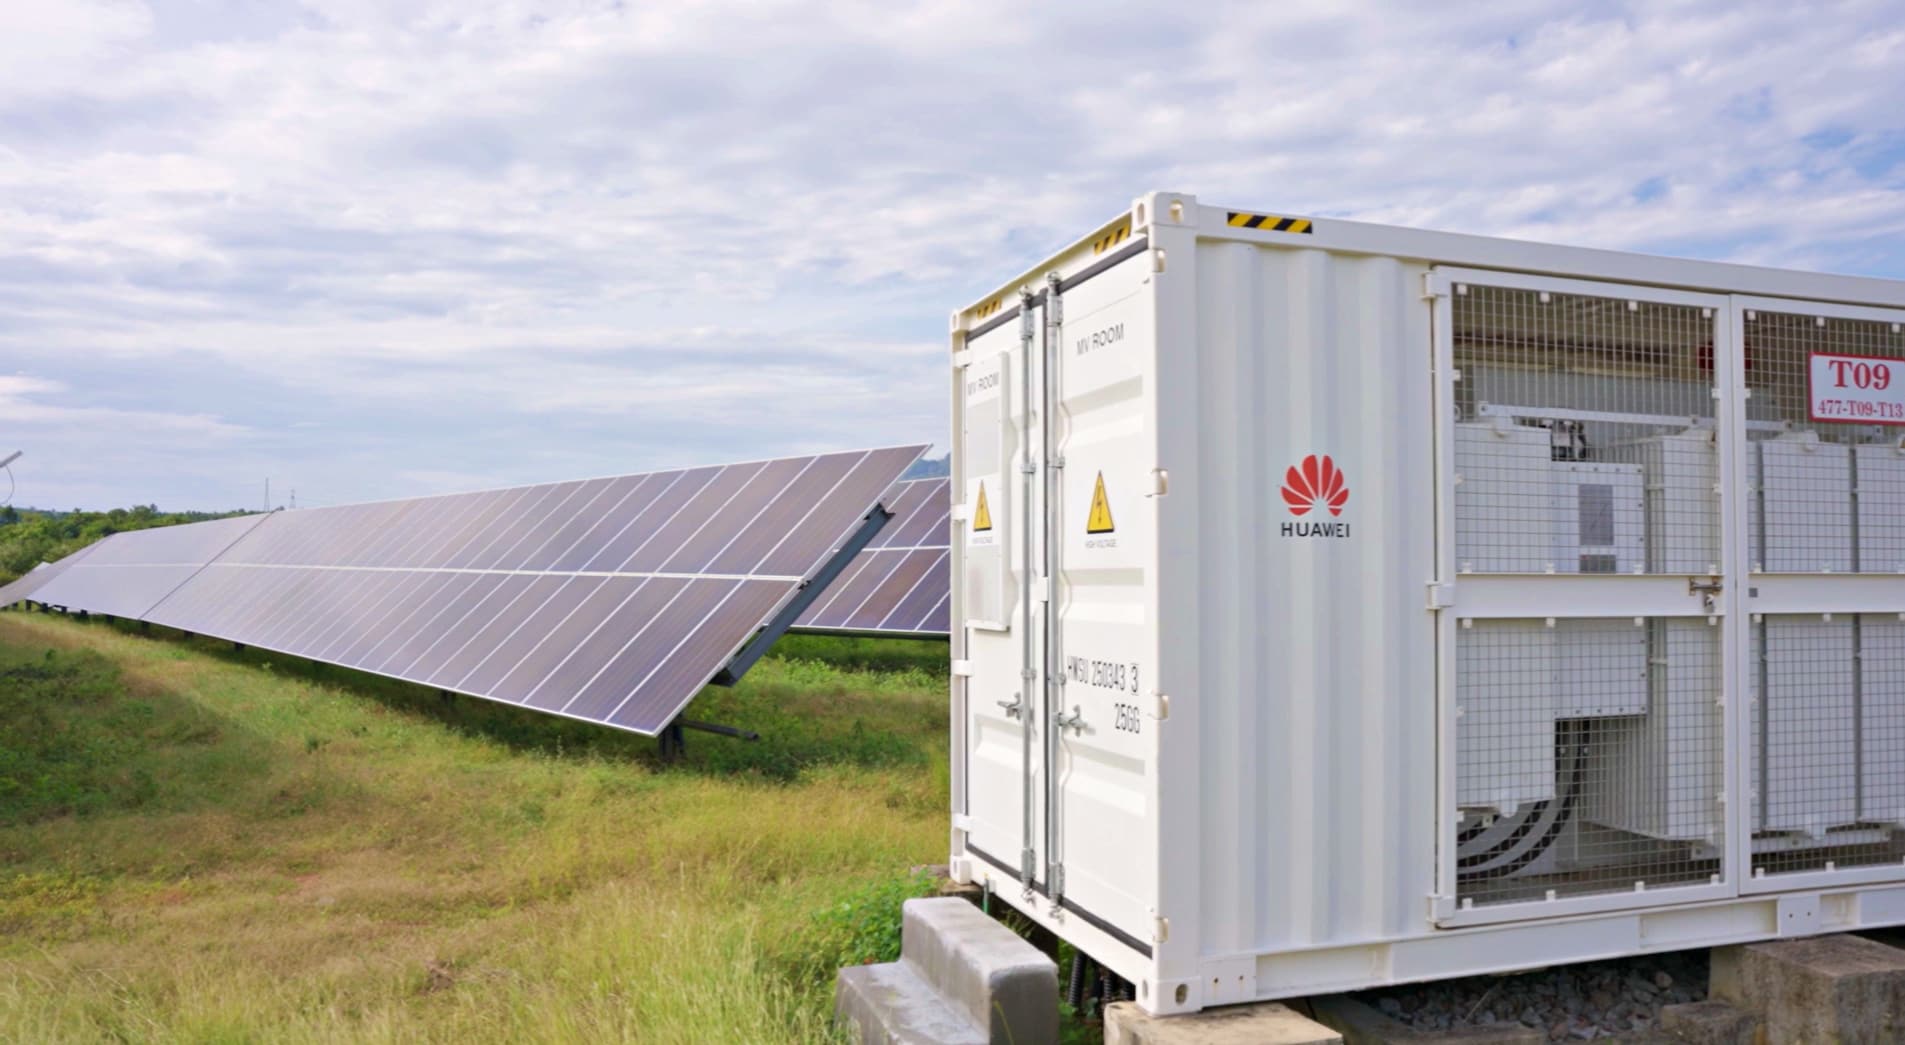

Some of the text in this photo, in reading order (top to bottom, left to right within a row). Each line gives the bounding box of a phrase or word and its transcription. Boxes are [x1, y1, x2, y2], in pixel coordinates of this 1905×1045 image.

[1076, 323, 1124, 355] MV ROOM
[978, 372, 1000, 390] ROOM
[1828, 359, 1890, 391] T09
[1818, 399, 1904, 418] 477-T09-T13
[1281, 522, 1350, 538] HUAWEI
[1067, 656, 1139, 695] HWSU 250343 3
